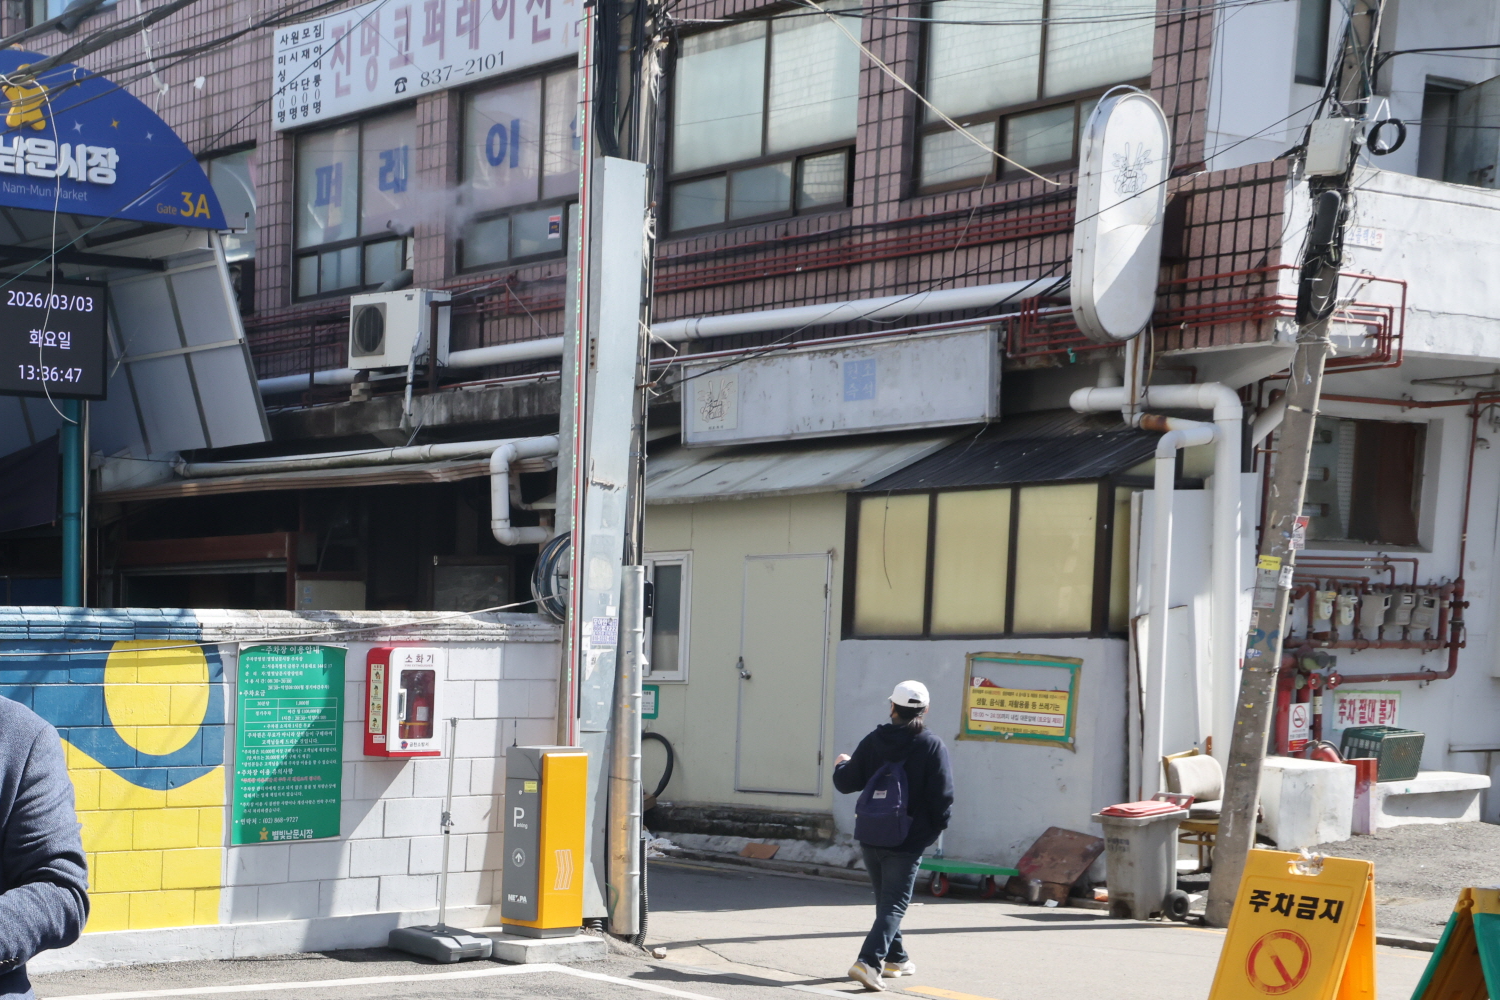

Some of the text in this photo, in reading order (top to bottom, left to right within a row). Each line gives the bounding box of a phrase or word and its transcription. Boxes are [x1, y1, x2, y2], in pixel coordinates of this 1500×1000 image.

[280, 23, 323, 46] 사원모집
[420, 51, 506, 88] 837-2101
[3, 181, 52, 196] Nam-Mun
[55, 187, 88, 201] Market
[156, 191, 211, 219] Gate 3A
[7, 290, 93, 312] 2026/03/03
[29, 329, 71, 350] 화요일
[18, 364, 83, 383] 13:36:47
[272, 829, 313, 840] 별빛남문시장
[1249, 889, 1345, 924] 주차금지
